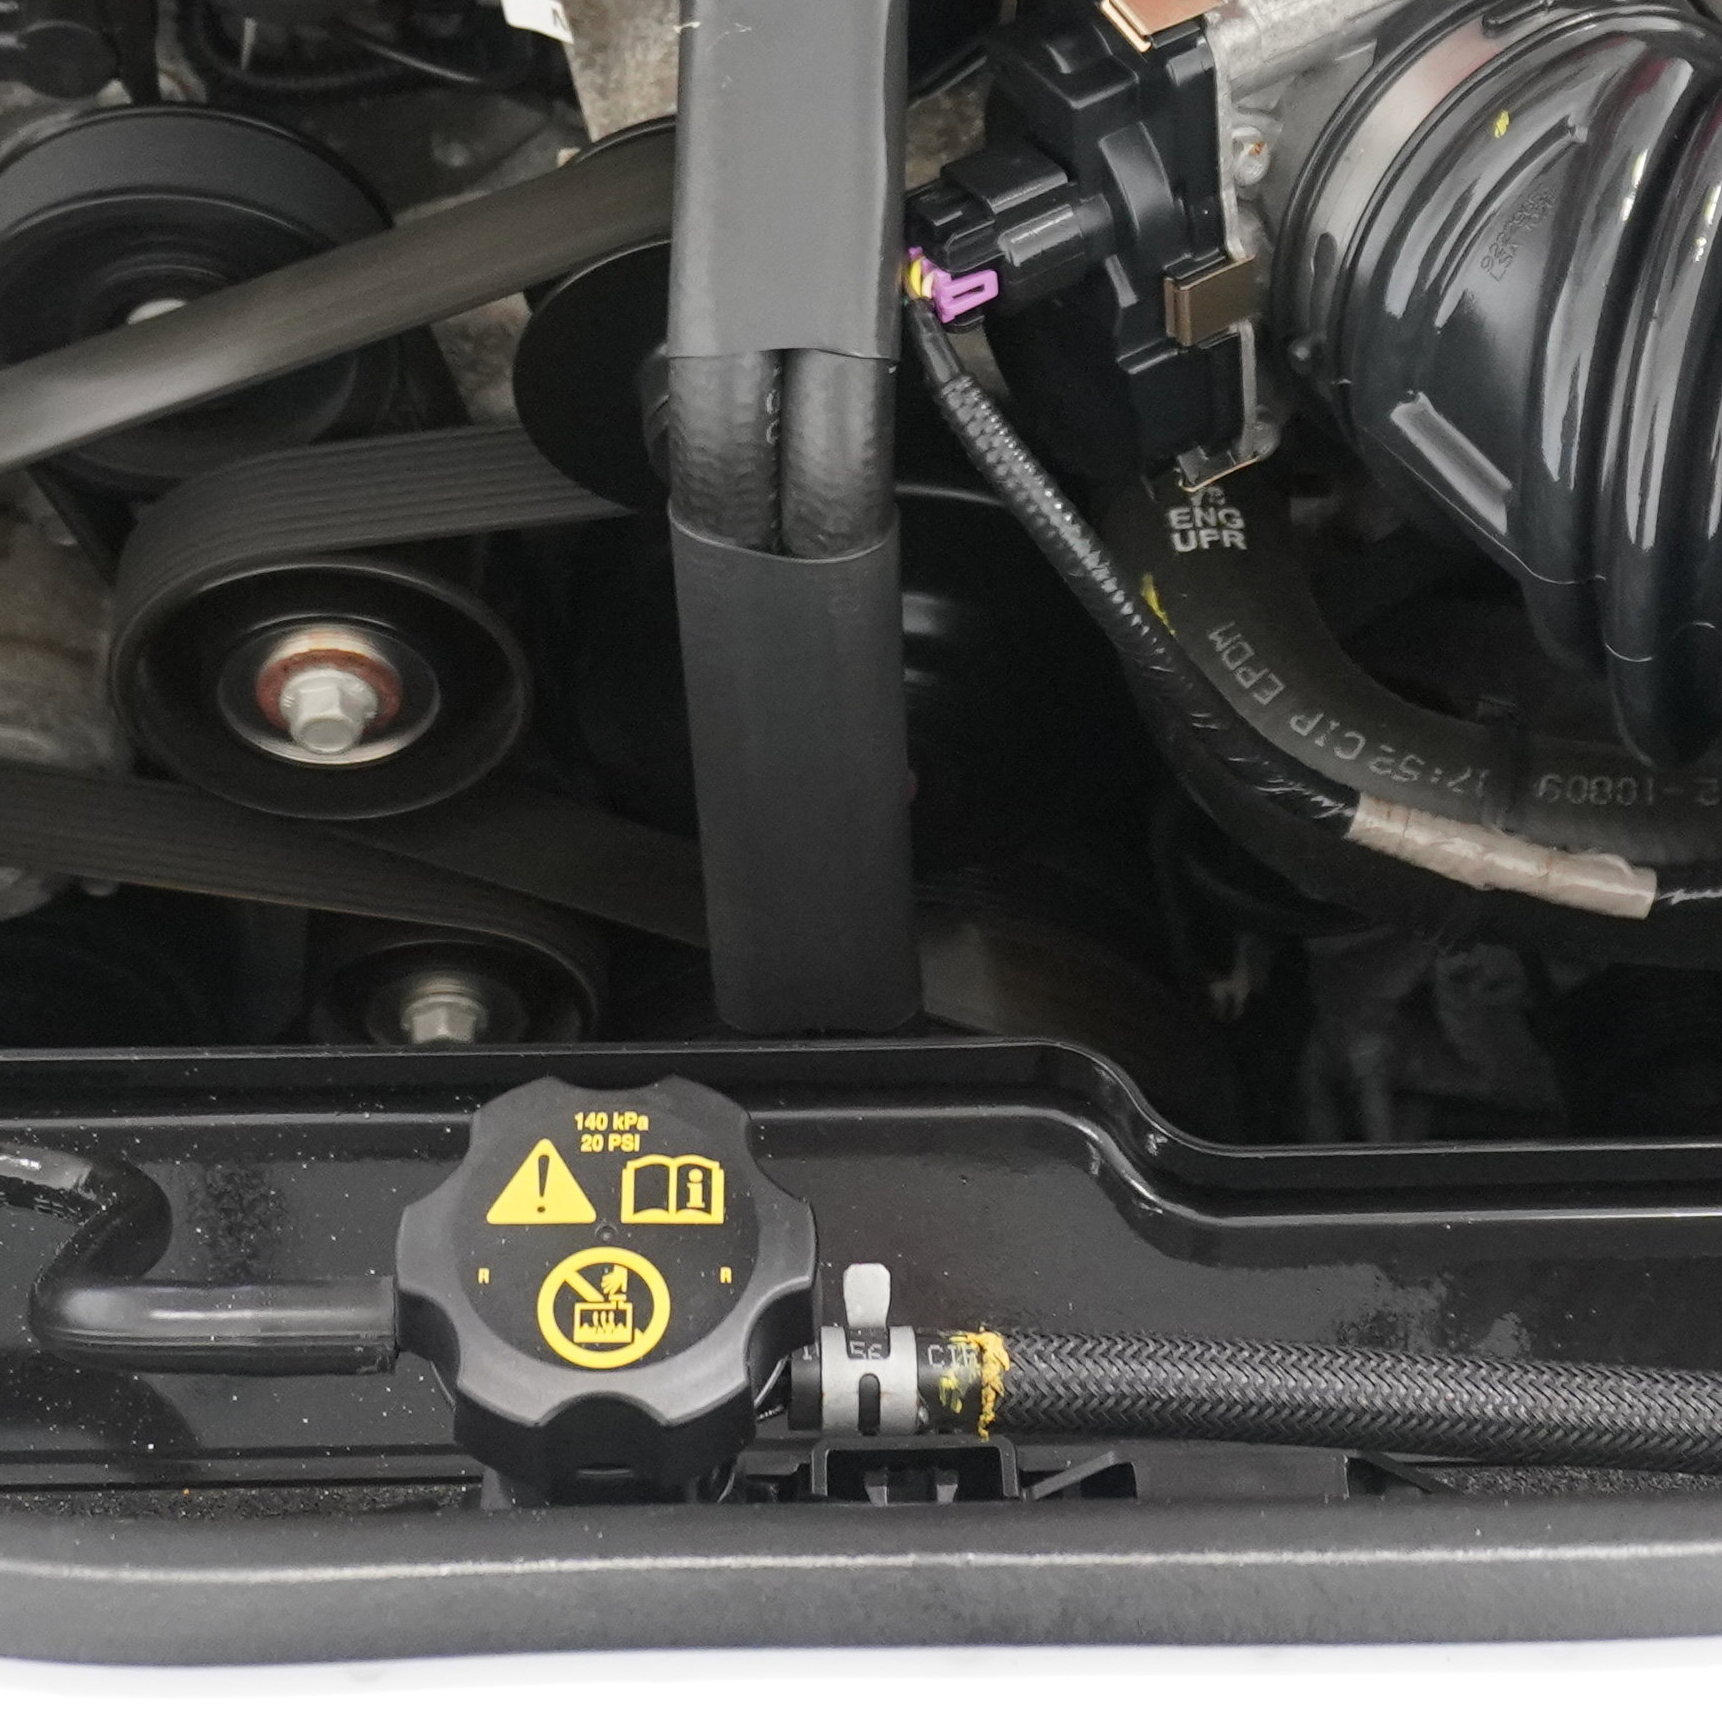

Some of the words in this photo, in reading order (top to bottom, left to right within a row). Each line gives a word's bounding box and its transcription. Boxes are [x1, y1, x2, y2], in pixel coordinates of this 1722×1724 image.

[1166, 506, 1245, 530] ENG
[1170, 529, 1247, 552] UPR
[1208, 622, 1286, 705] EPDM
[574, 1111, 608, 1131] 140
[612, 1110, 649, 1131] kPa
[580, 1133, 604, 1152] 20
[608, 1133, 640, 1152] PSI
